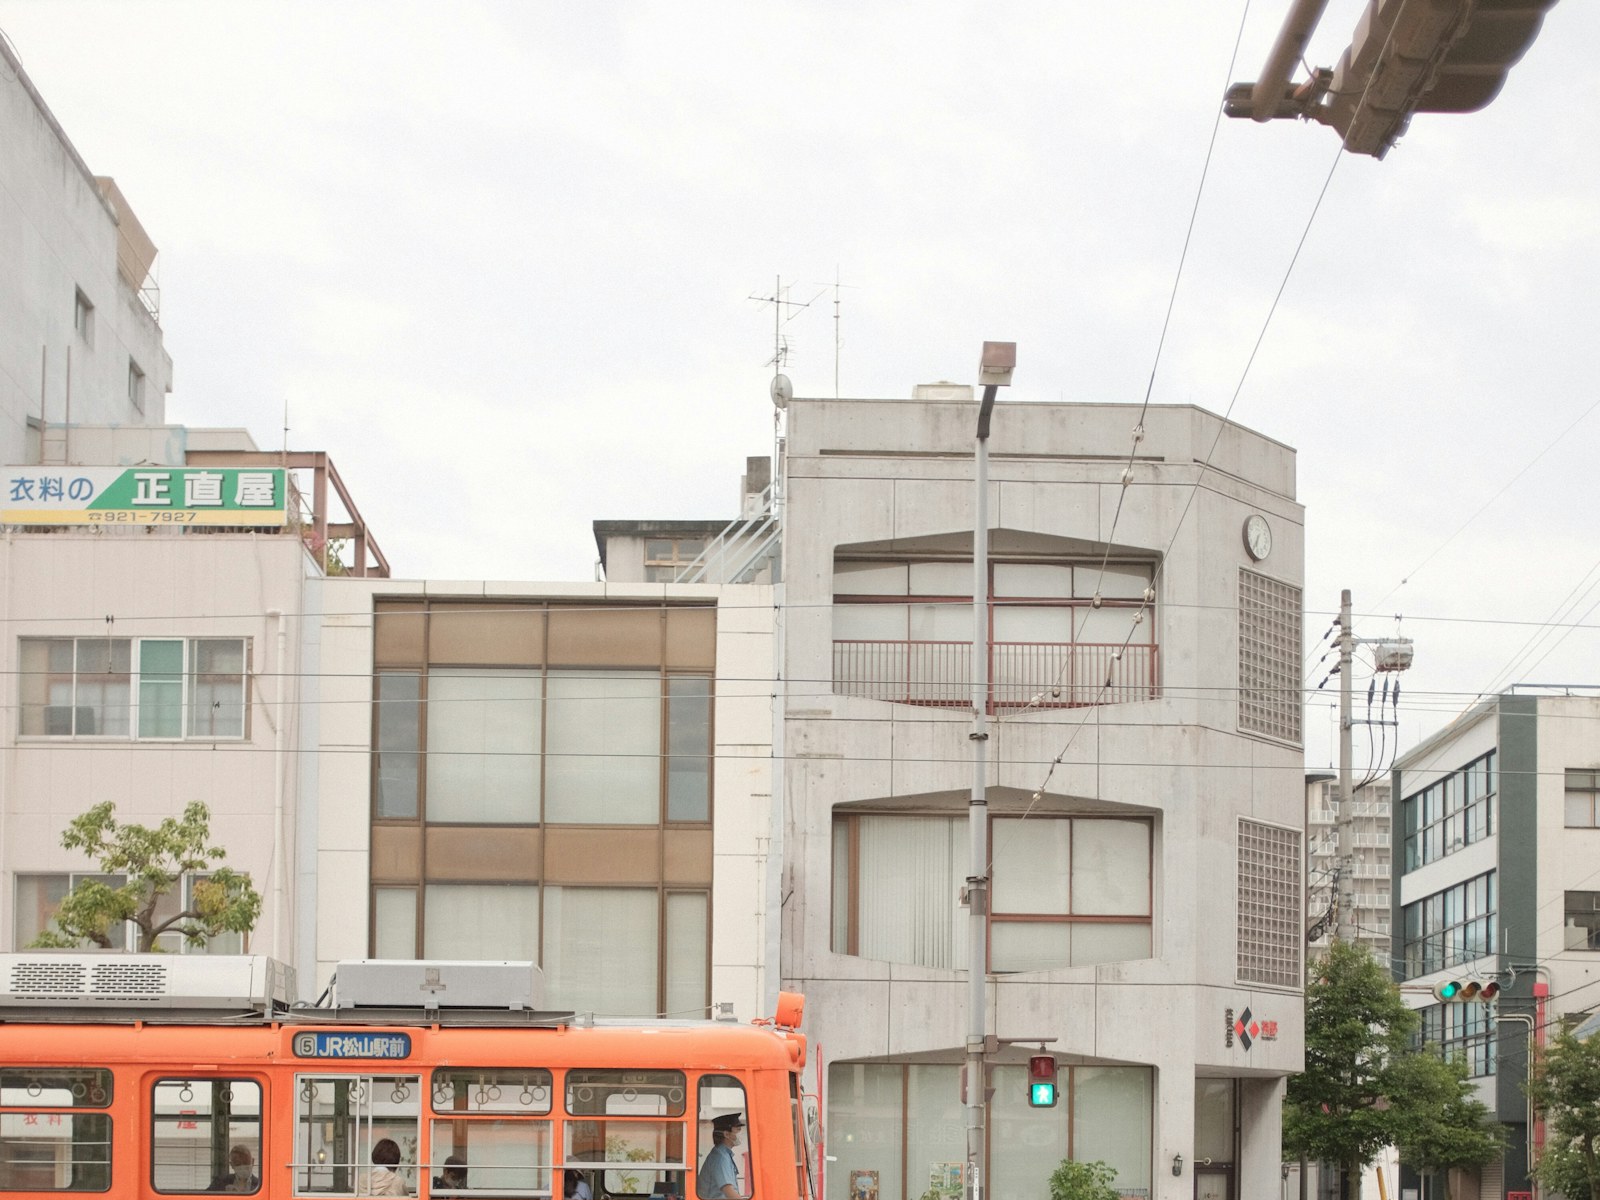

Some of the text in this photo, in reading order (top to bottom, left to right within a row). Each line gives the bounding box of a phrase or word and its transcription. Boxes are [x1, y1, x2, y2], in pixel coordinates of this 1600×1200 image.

[10, 471, 276, 507] 衣料の 正直屋
[104, 511, 197, 522] 921-7927
[303, 1036, 405, 1058] 5 JR松山駅前
